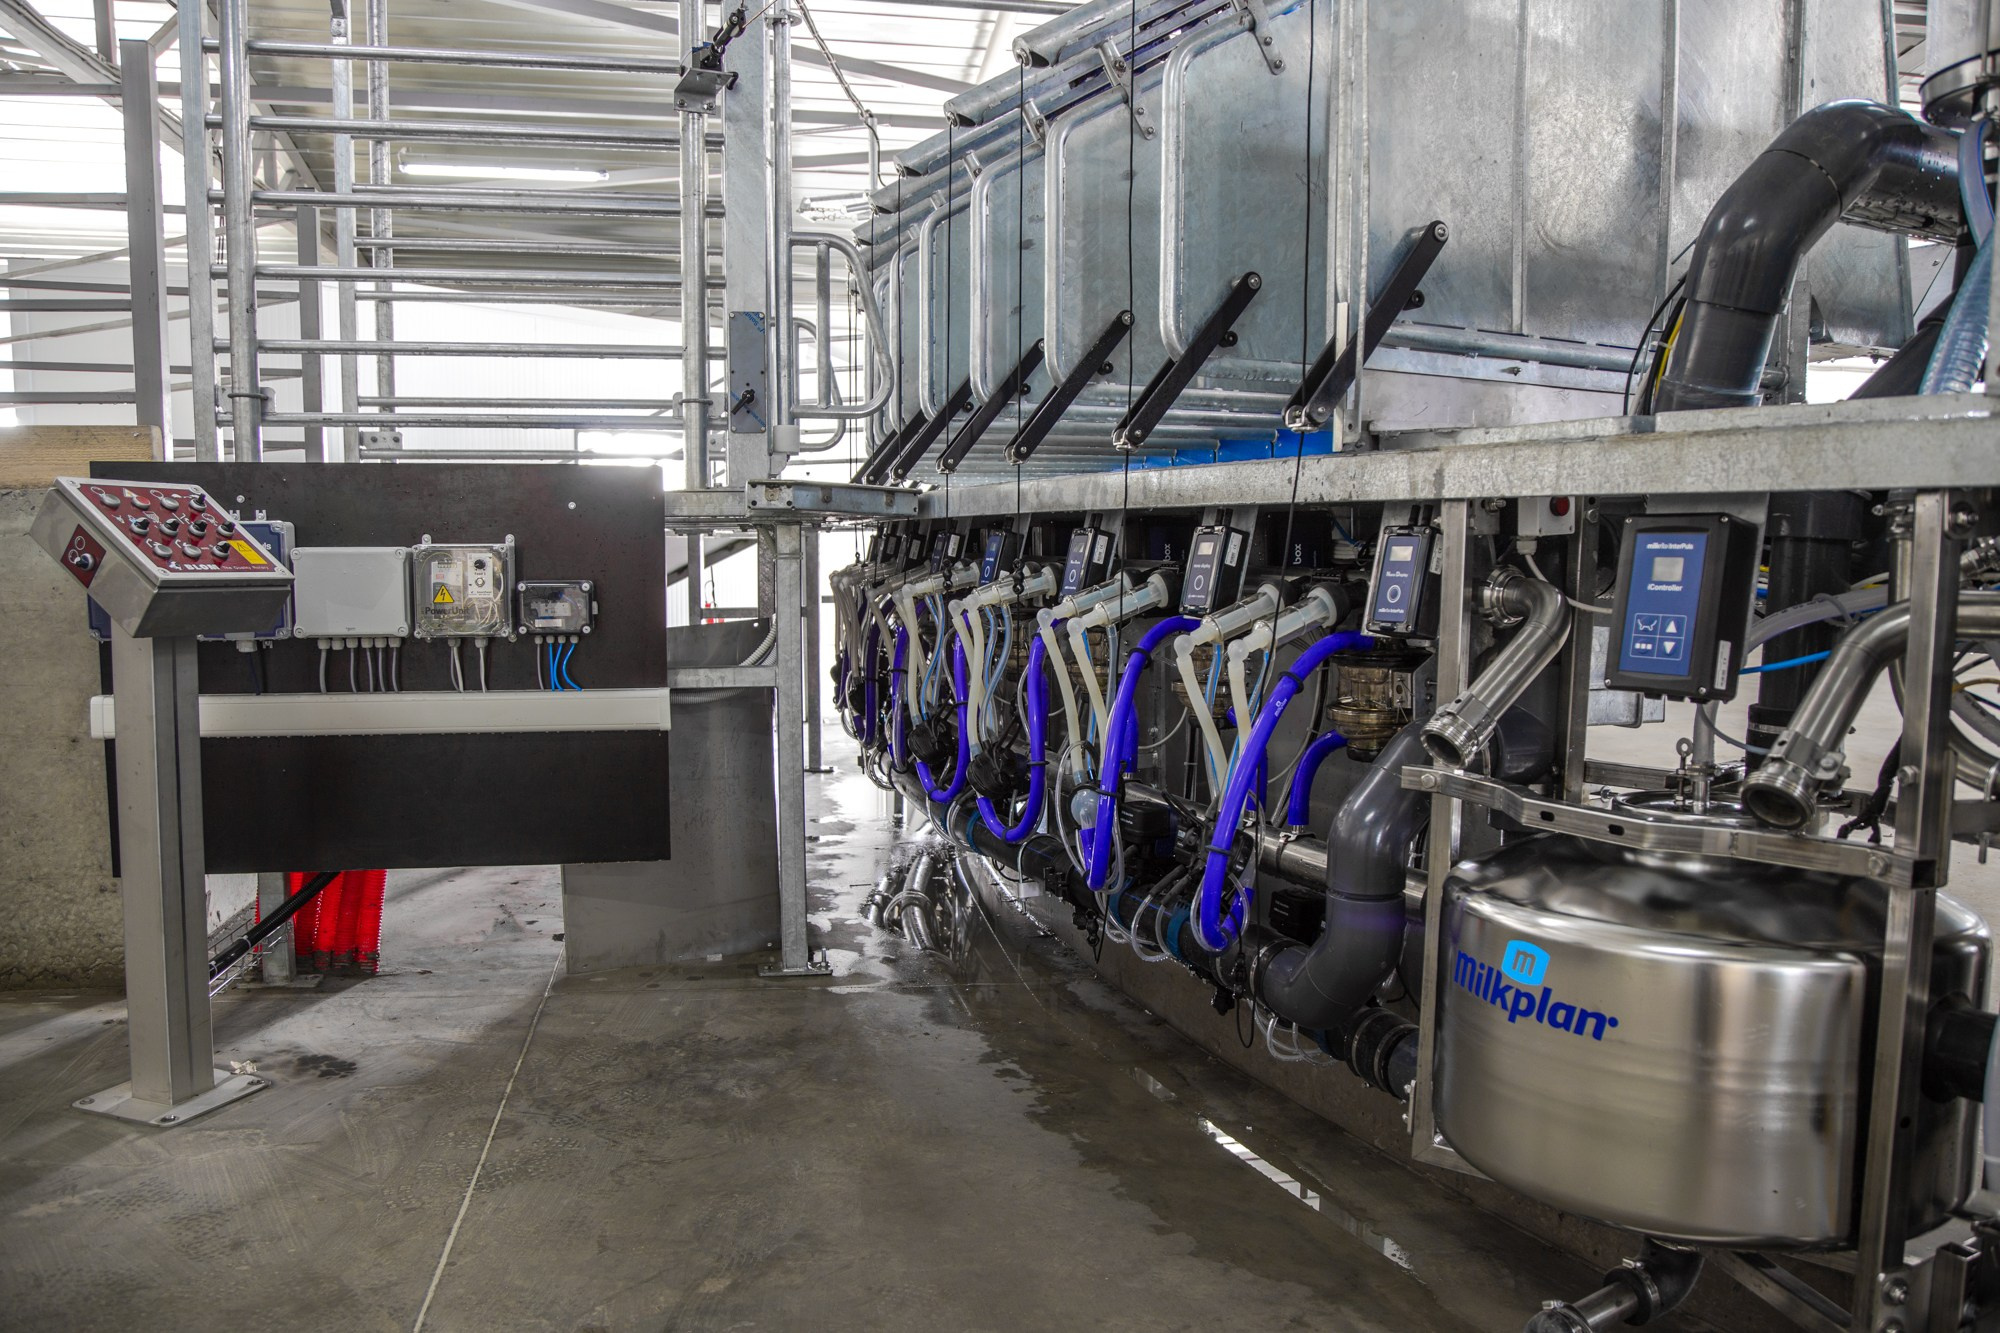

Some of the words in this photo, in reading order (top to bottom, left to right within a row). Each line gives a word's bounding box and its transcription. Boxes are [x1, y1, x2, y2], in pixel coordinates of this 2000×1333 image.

[1292, 543, 1302, 565] box
[1647, 583, 1683, 591] iController
[1454, 950, 1608, 1041] milkplan
